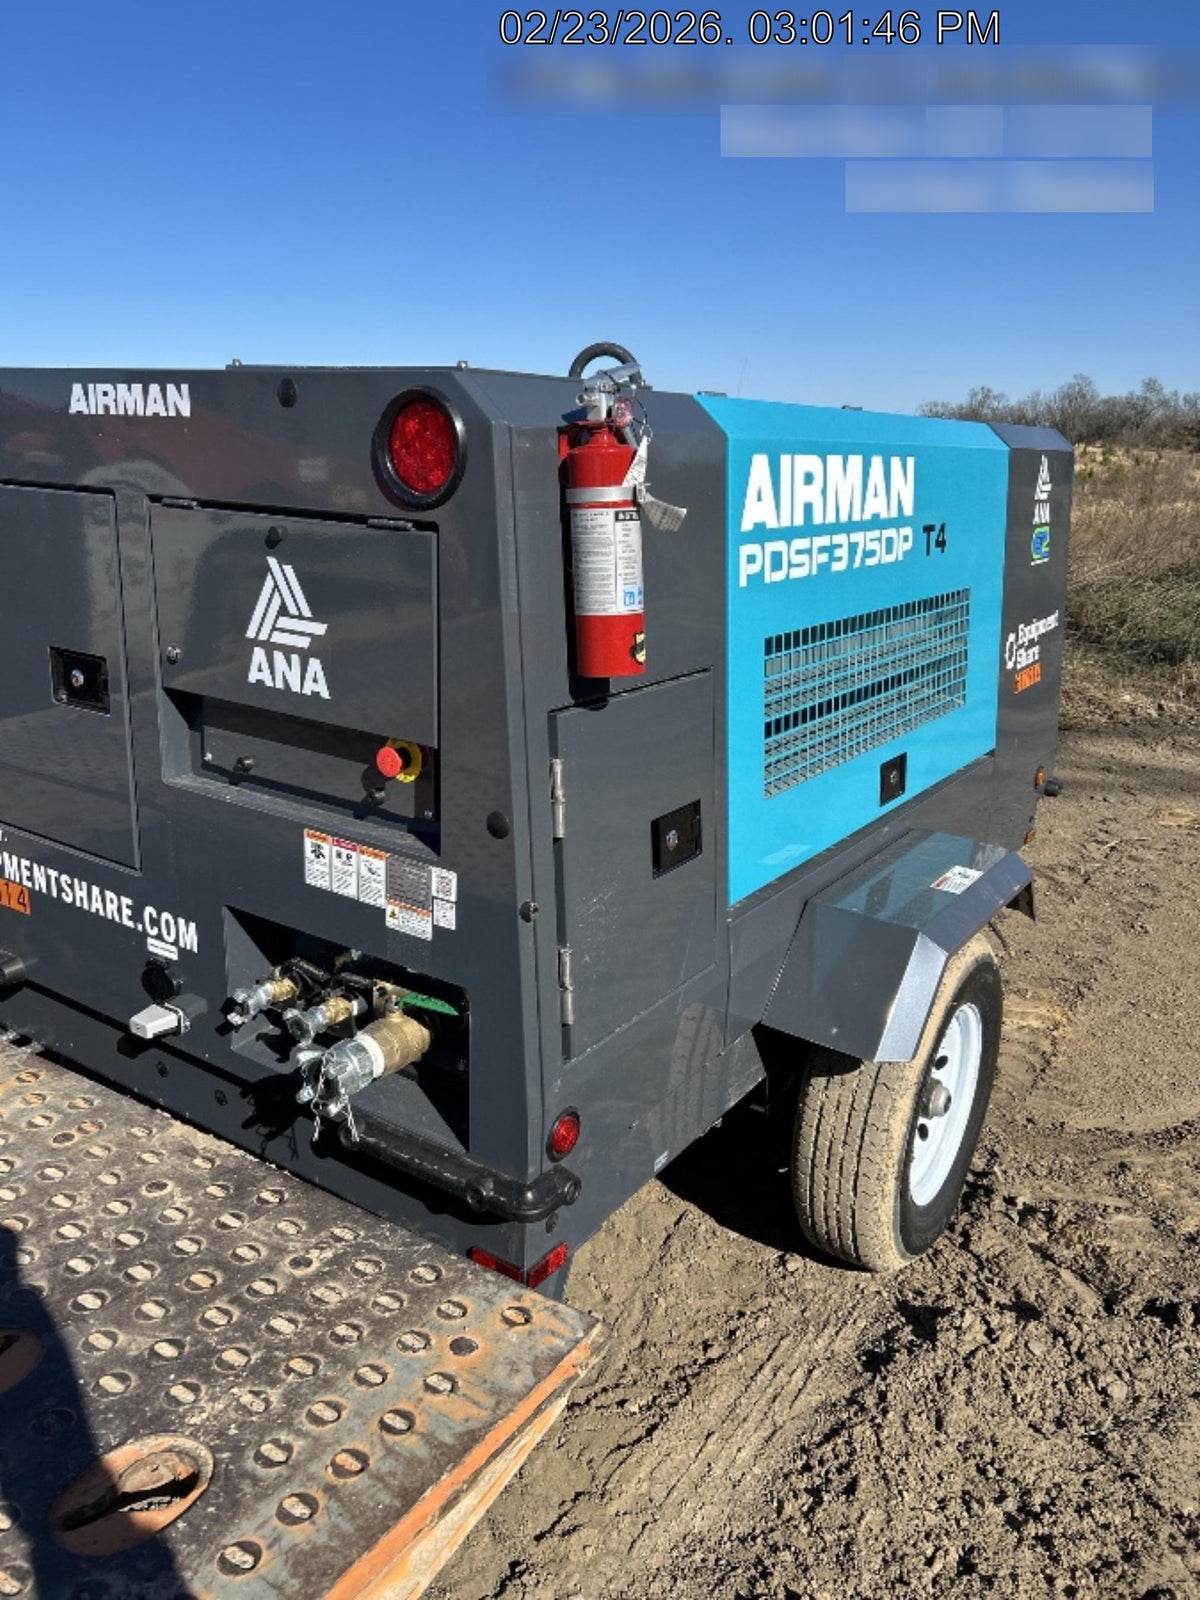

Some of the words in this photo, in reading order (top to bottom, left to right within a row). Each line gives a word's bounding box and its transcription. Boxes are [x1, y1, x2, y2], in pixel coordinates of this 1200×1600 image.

[68, 382, 192, 418] AIRMAN
[740, 453, 916, 532] AIRMAN
[738, 525, 914, 588] PDSF375DP
[922, 522, 948, 557] T4
[247, 646, 332, 700] ANA
[0, 850, 199, 954] MENTSHARE.COM
